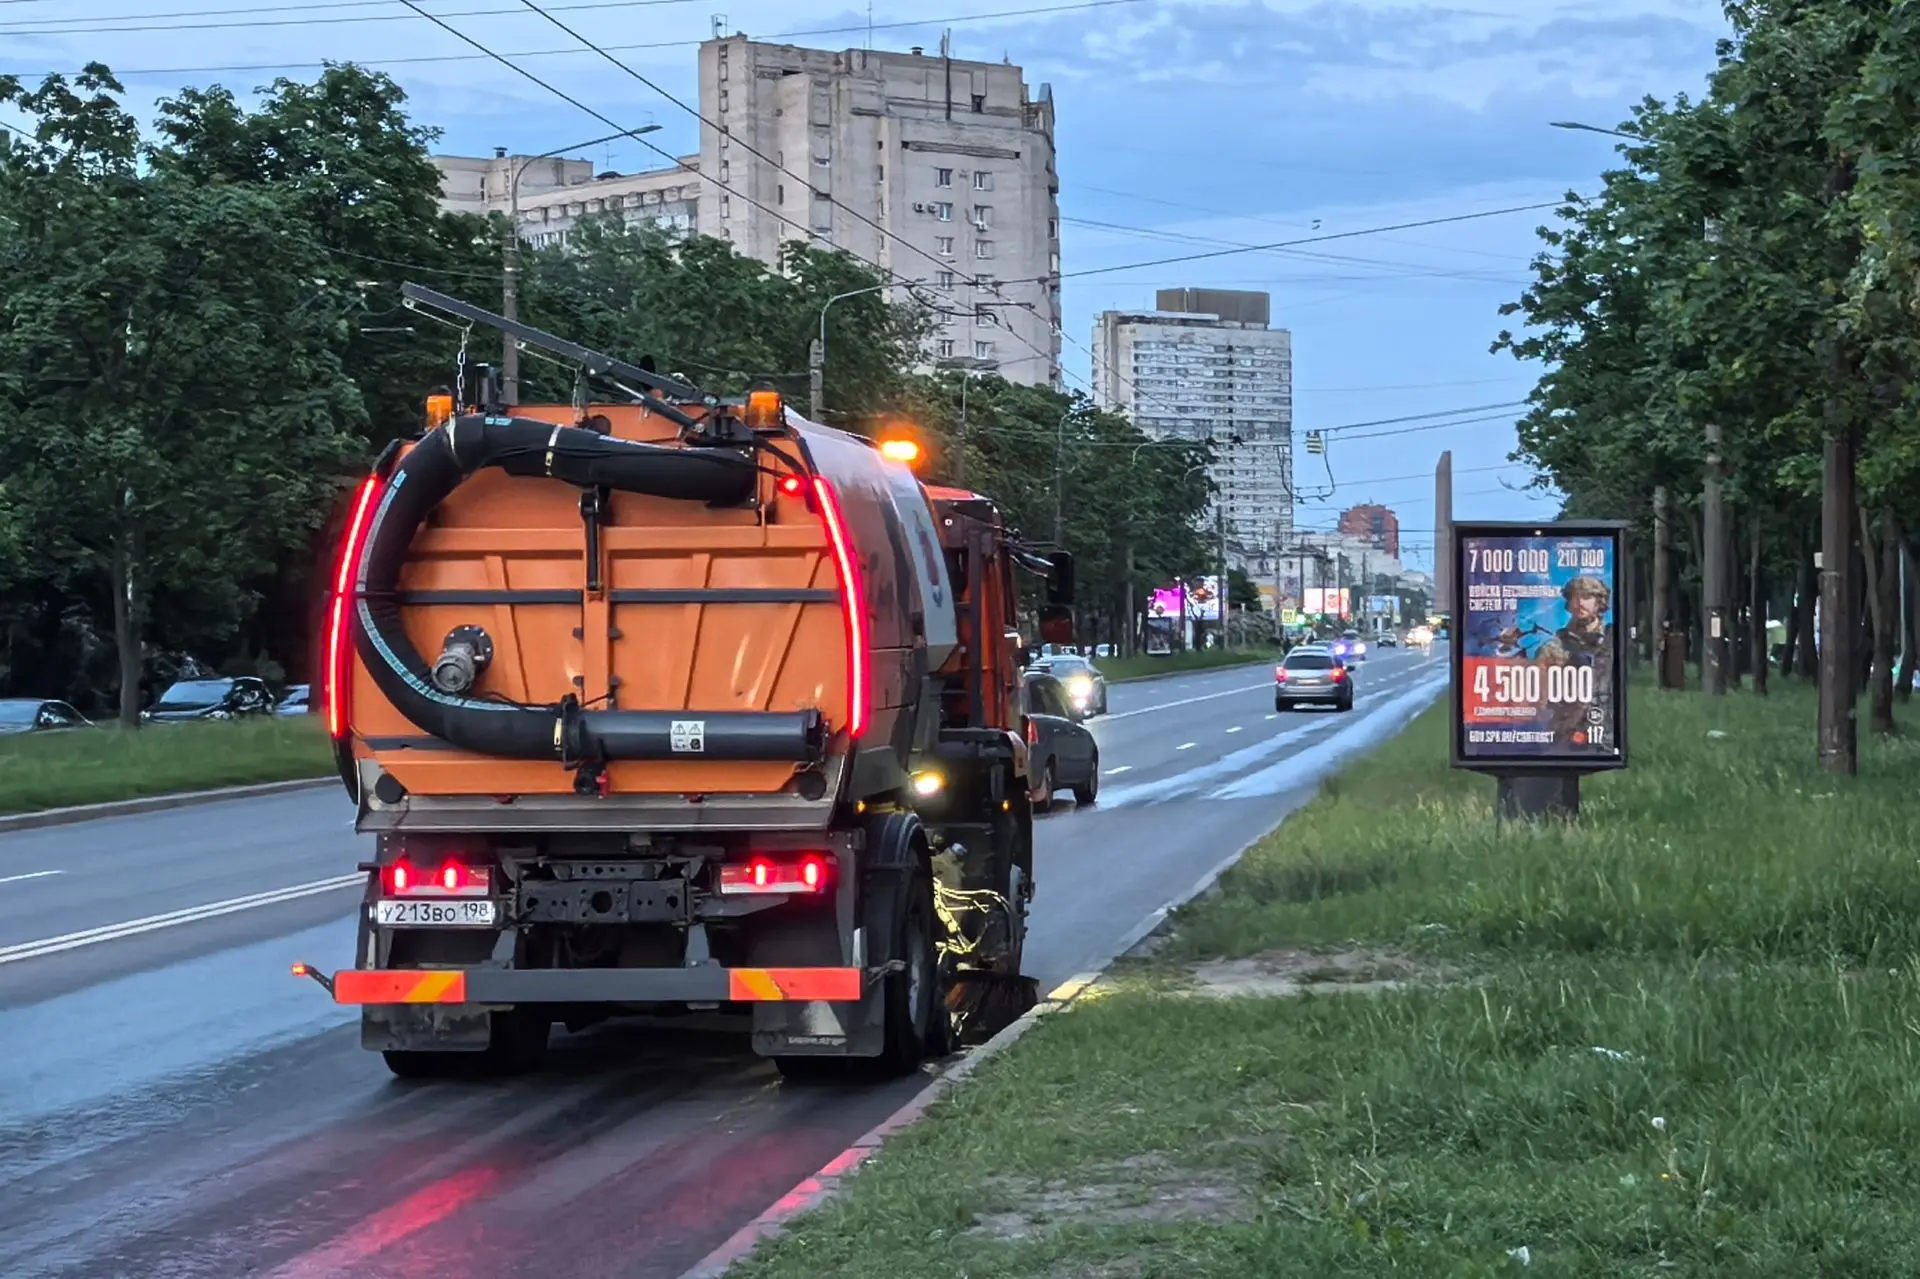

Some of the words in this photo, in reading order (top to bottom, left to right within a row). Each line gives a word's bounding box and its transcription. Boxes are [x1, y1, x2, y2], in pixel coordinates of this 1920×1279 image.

[1469, 549, 1477, 573] 7
[1483, 549, 1513, 573] 000
[1518, 549, 1549, 573] 000
[1557, 549, 1578, 567] 210
[1581, 549, 1604, 567] 000
[1473, 665, 1490, 702] 4
[1495, 665, 1540, 703] 500
[1547, 665, 1593, 703] 000
[1587, 726, 1604, 743] 117
[384, 903, 456, 922] У213ВО
[461, 903, 488, 920] 198
